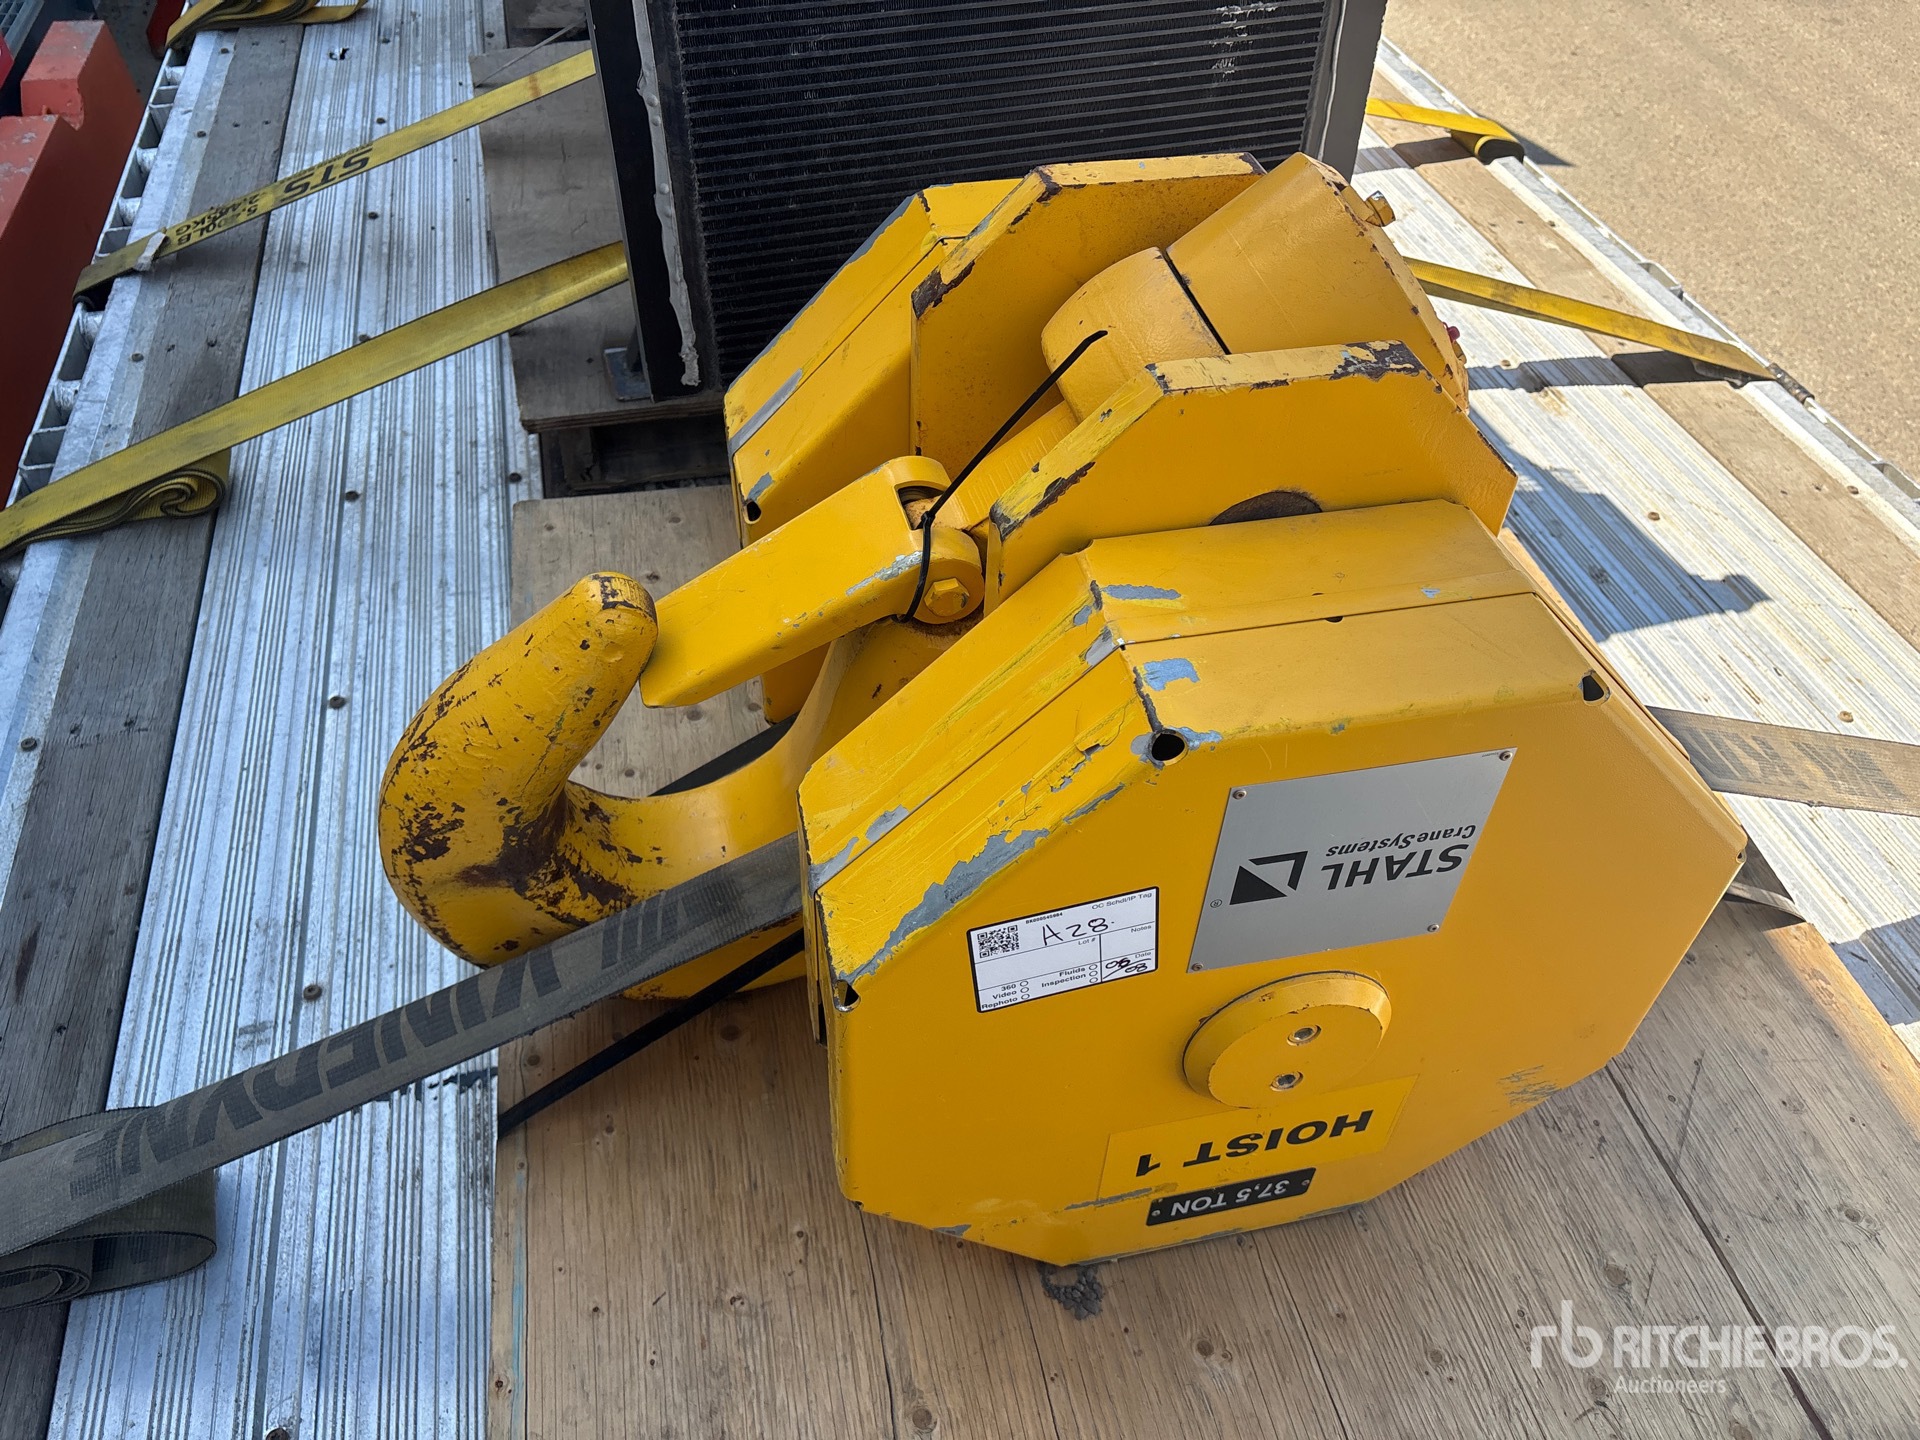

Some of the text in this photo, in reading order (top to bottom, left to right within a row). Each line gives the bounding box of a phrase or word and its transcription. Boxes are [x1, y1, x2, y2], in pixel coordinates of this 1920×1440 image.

[282, 148, 373, 202] STS
[1321, 844, 1470, 890] STAHL
[1139, 892, 1152, 900] Tag
[1131, 925, 1152, 933] Notes
[1135, 951, 1151, 959] Date
[1059, 967, 1086, 978] Fluids
[1041, 974, 1086, 988] Inspection
[1001, 983, 1017, 991] 360
[993, 990, 1017, 1000] Video
[982, 997, 1018, 1009] Rephoto
[1136, 1109, 1374, 1177] HOIST 1
[1171, 1179, 1290, 1217] 37,5 TON
